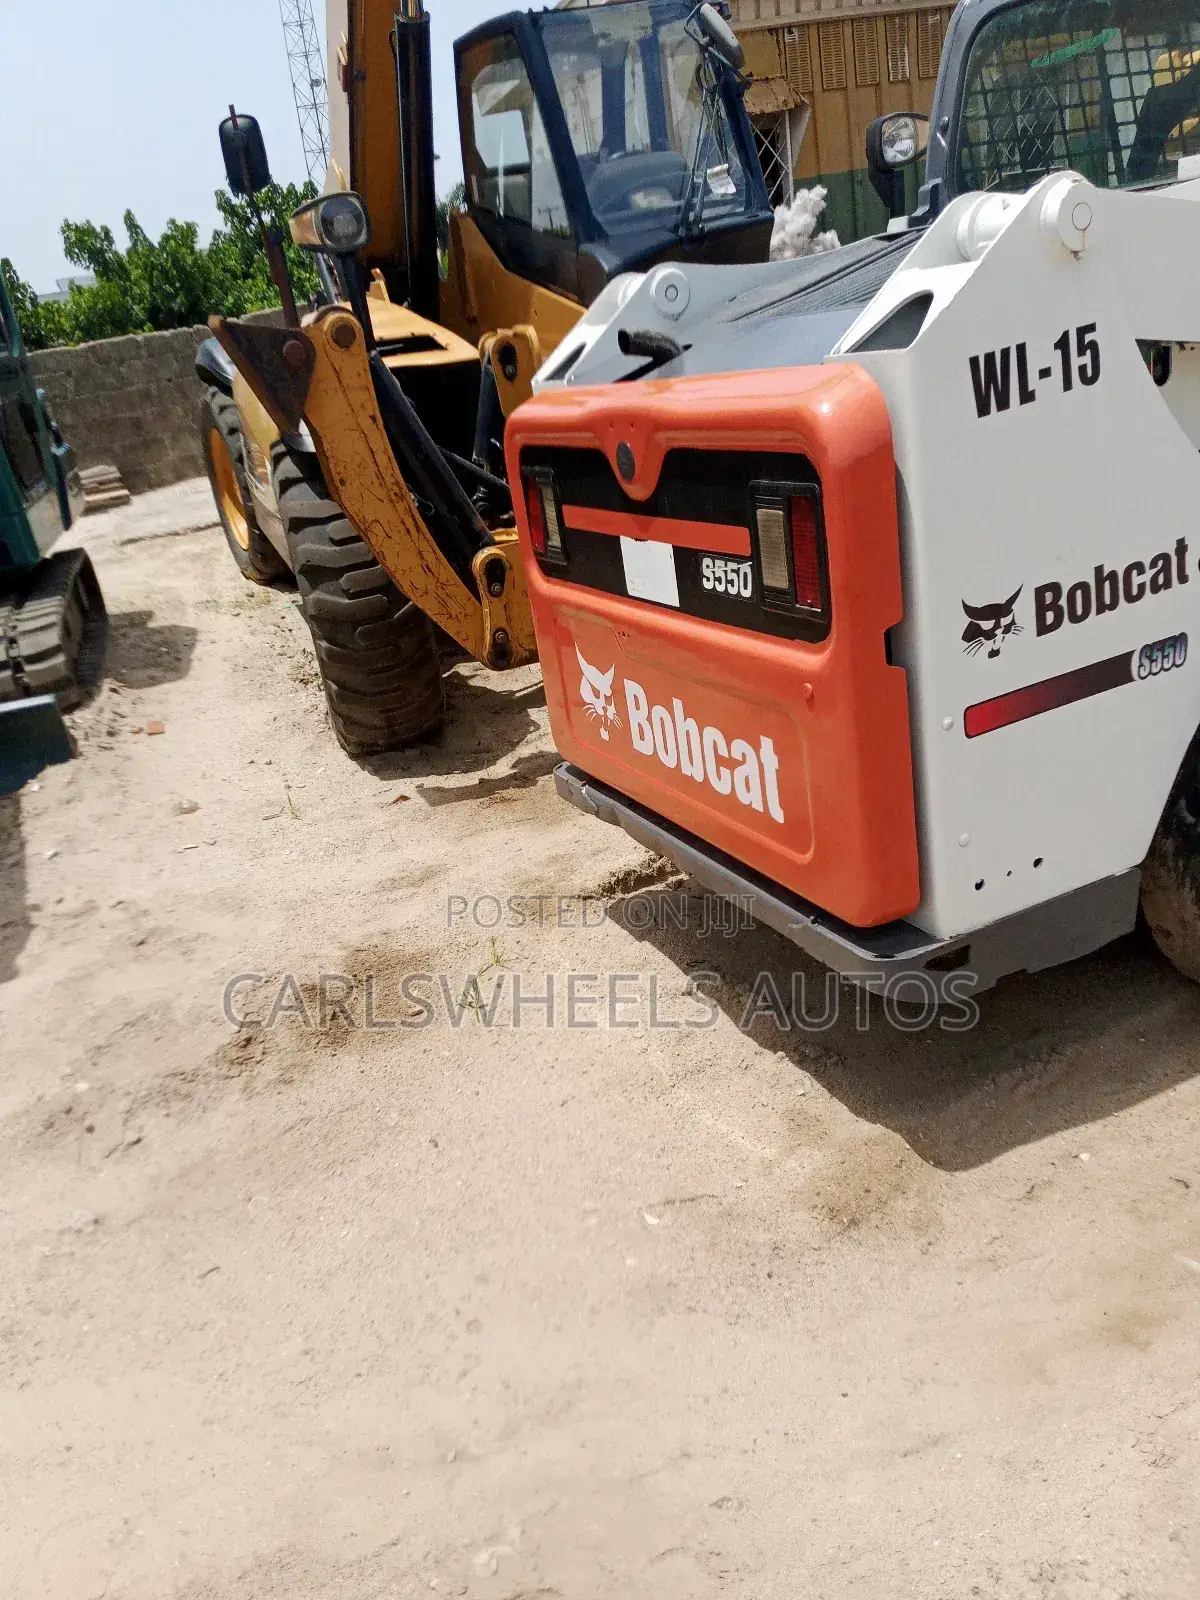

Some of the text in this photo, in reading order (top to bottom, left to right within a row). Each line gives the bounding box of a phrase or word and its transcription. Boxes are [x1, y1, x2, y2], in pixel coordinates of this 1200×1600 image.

[968, 321, 1101, 419] WL-15
[701, 556, 753, 598] S550
[1033, 536, 1190, 638] Bobcat
[1137, 631, 1189, 680] S550
[623, 677, 784, 824] Bobcat
